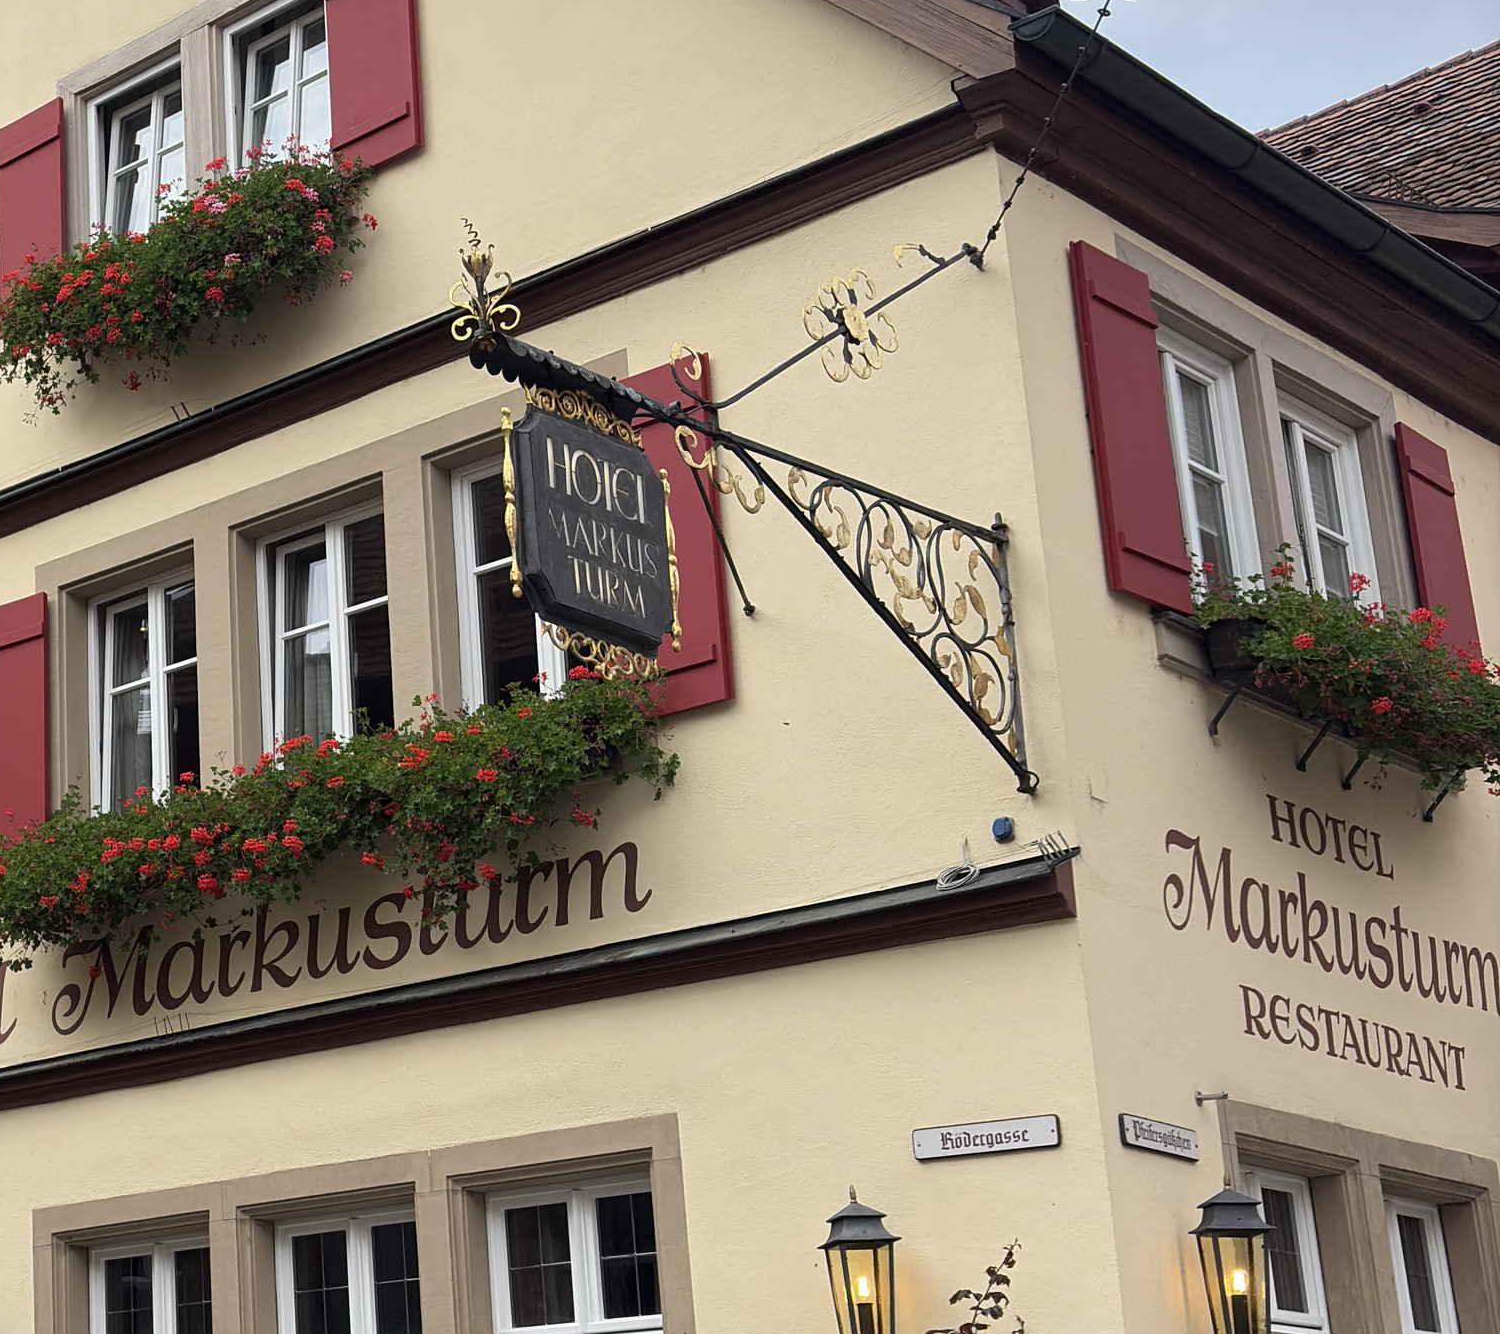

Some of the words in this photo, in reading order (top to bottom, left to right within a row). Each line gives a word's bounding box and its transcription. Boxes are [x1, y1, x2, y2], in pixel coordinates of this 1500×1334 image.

[546, 437, 652, 527] HOTEL
[548, 507, 658, 579] MARKUS
[568, 554, 647, 619] TURM
[1265, 794, 1394, 881] HOTEL
[52, 840, 653, 1036] Markusturm
[1163, 829, 1500, 1017] Markusturm
[1239, 984, 1466, 1091] RESTAURANT
[940, 1127, 1030, 1151] Rödergasse
